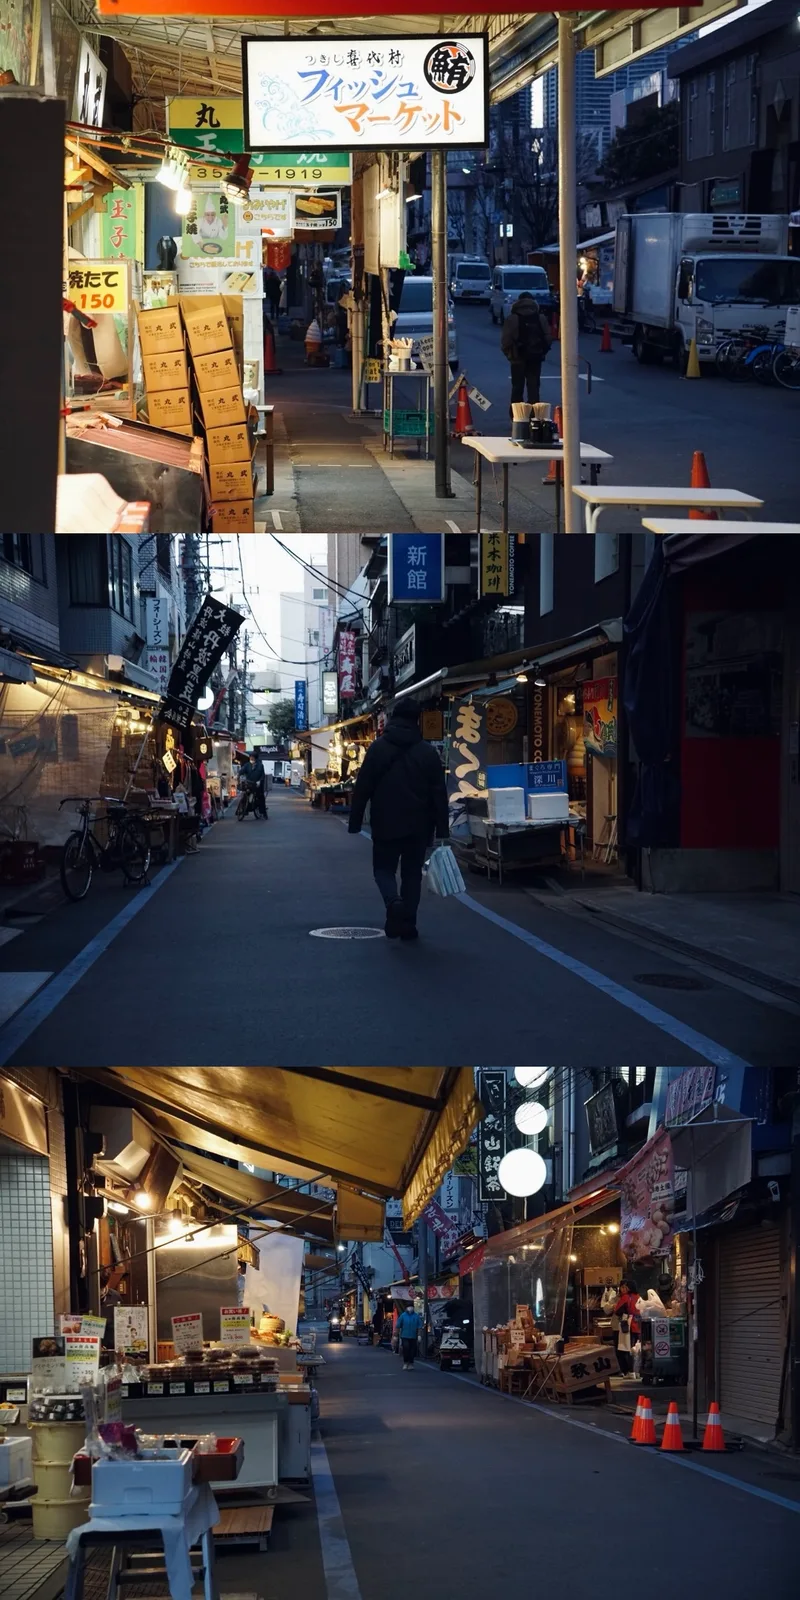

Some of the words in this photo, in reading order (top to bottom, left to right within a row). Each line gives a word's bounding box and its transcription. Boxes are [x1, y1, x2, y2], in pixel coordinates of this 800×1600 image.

[298, 68, 420, 101] フィッシュ
[334, 100, 462, 132] マーケット
[407, 546, 427, 590] 新館
[152, 600, 162, 645] フォーシーズン
[534, 687, 542, 747] YONEMOTO
[534, 774, 556, 784] 深川
[570, 1356, 612, 1379] 秋山
